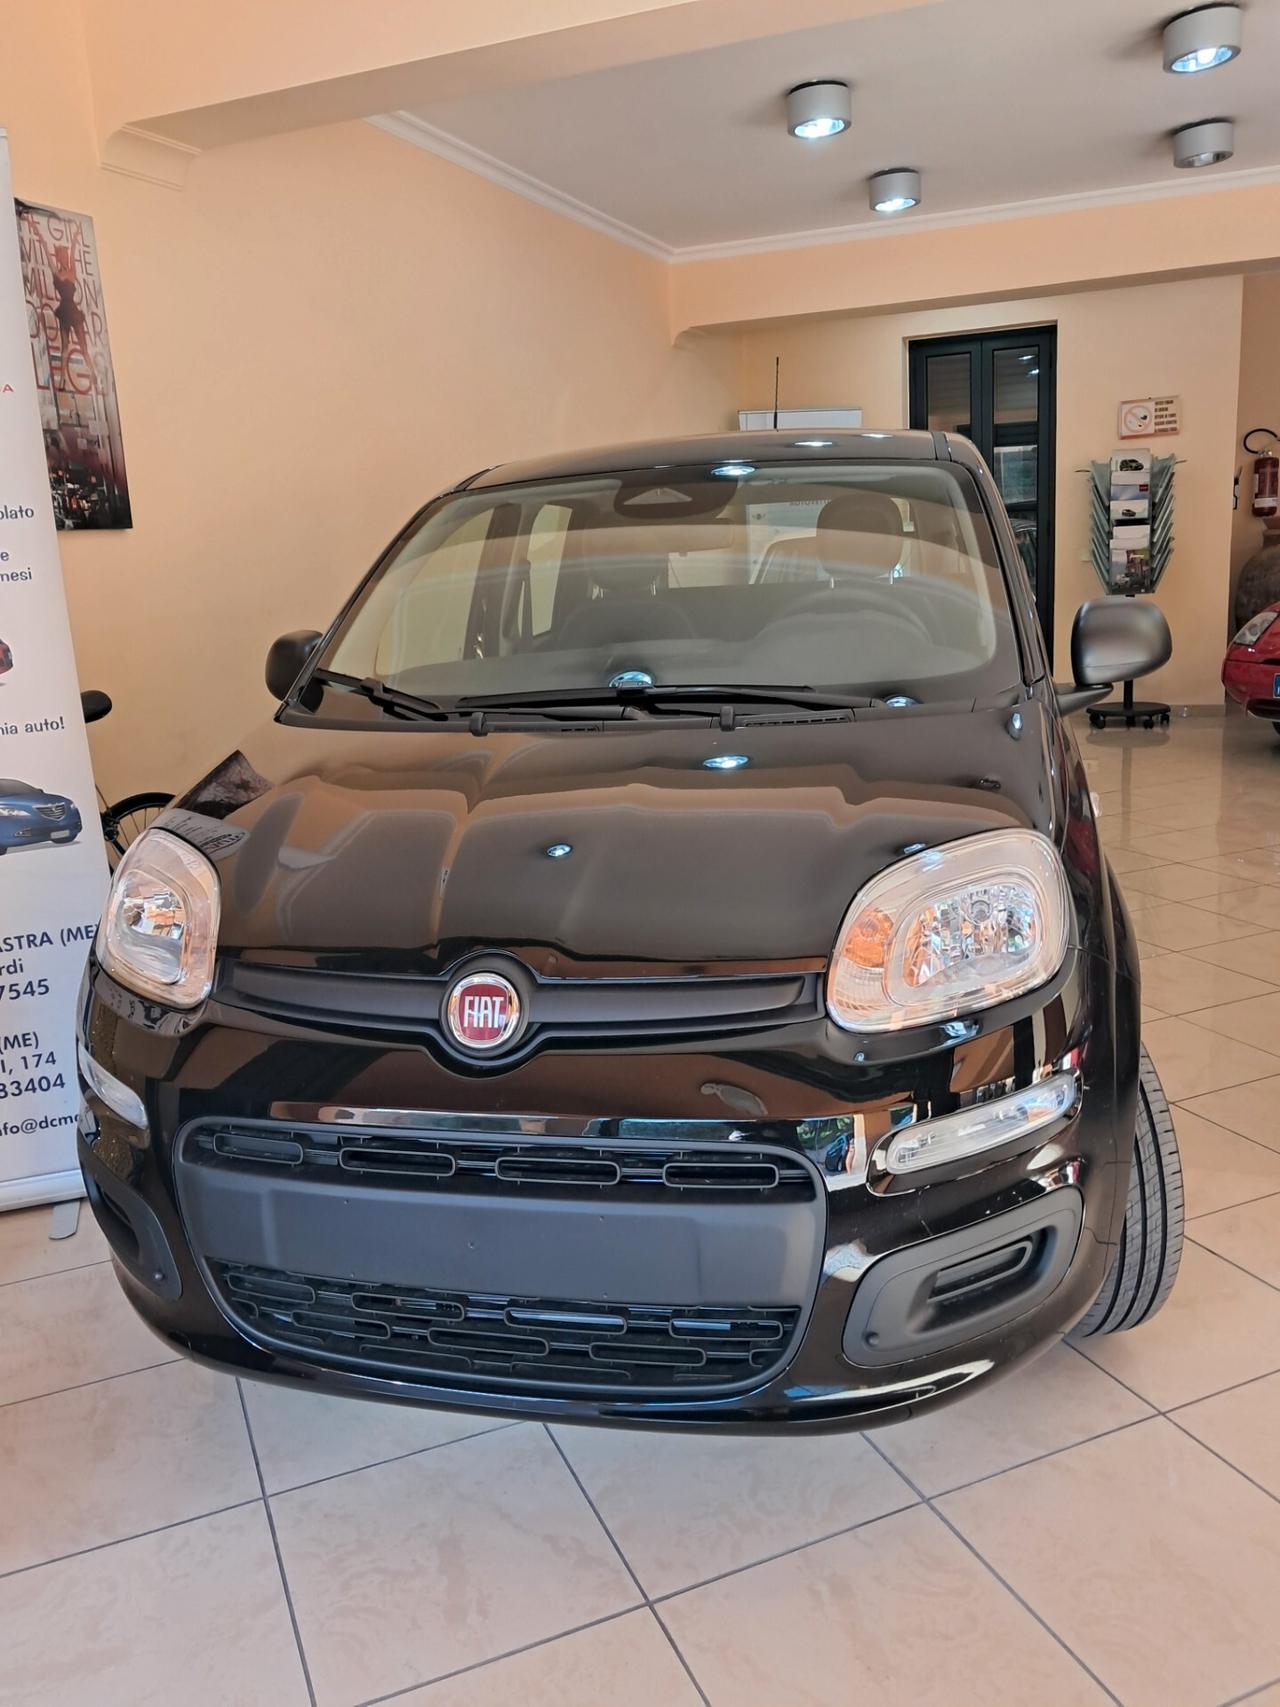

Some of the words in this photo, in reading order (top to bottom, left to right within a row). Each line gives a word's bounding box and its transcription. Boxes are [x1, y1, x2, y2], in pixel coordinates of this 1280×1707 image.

[24, 267, 98, 308] MILLON
[25, 716, 65, 733] auto!
[0, 931, 54, 953] STRA
[463, 995, 505, 1028] FIAT
[21, 1051, 57, 1070] 174
[0, 1114, 80, 1136] fo@dcm
